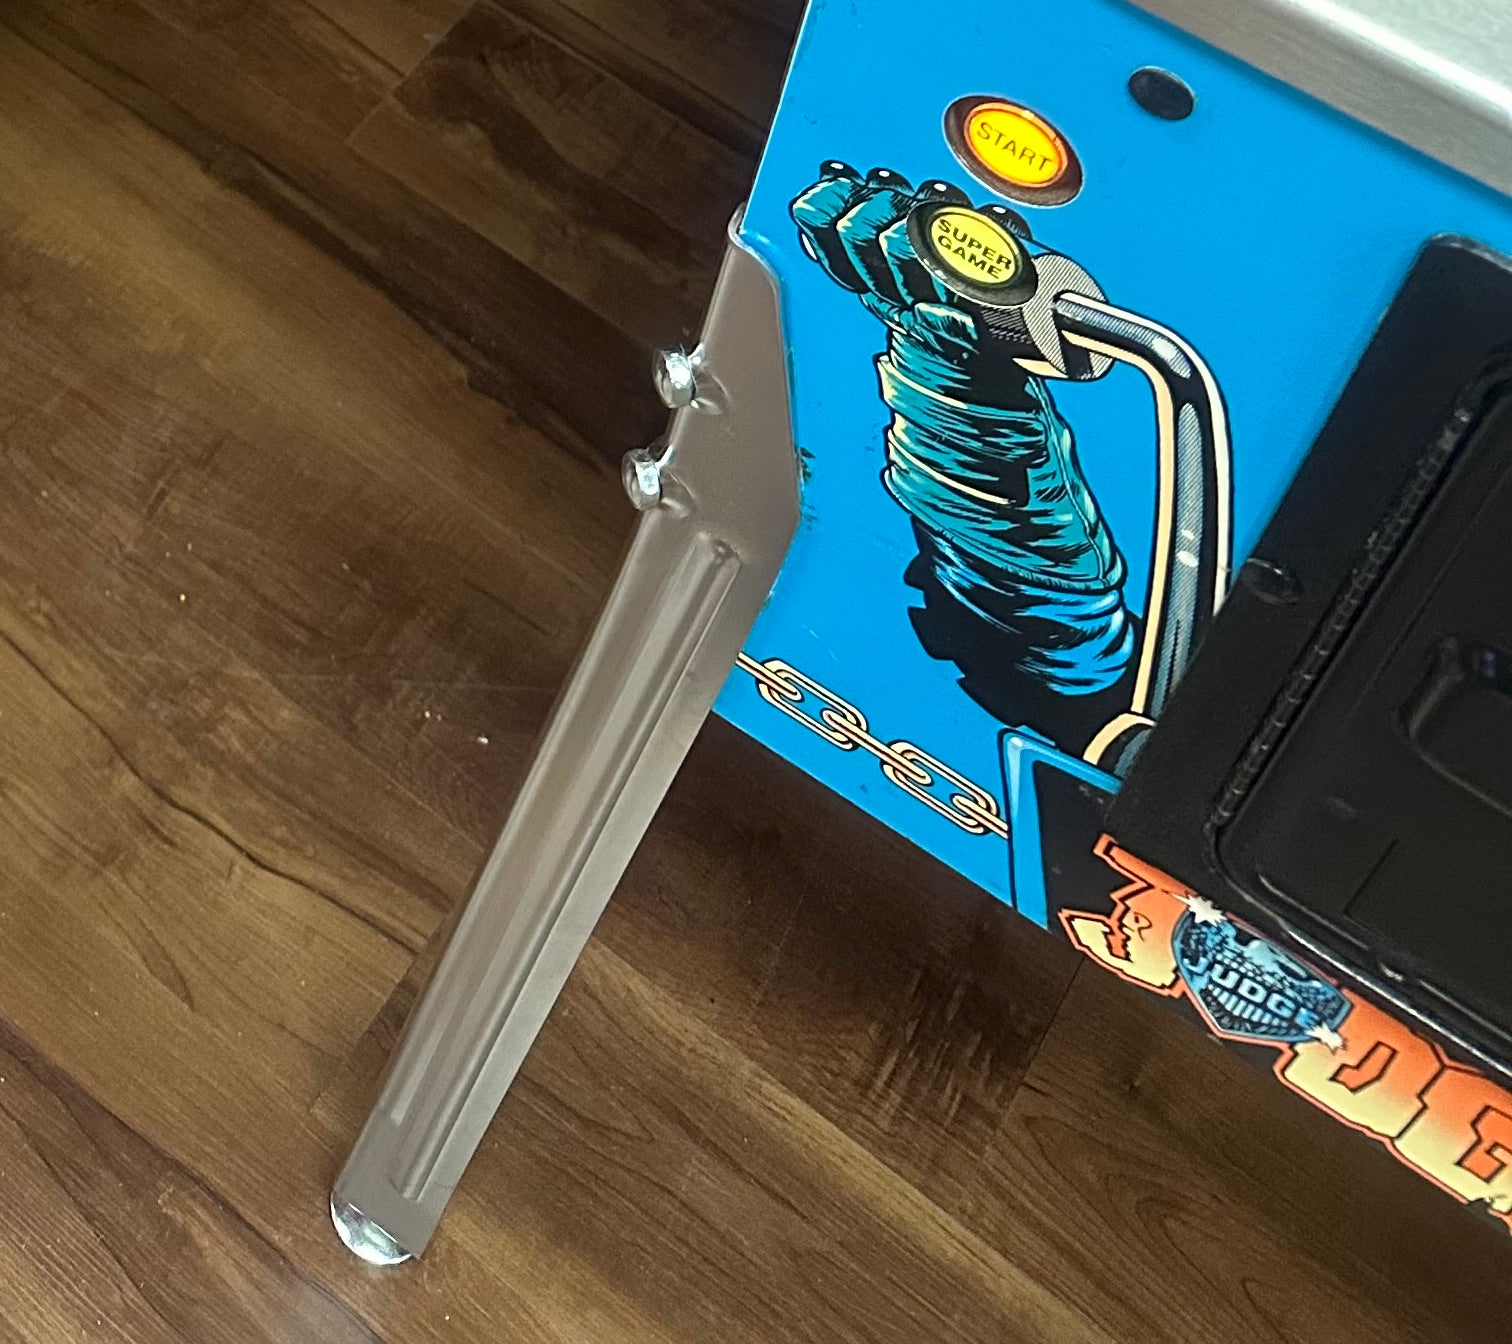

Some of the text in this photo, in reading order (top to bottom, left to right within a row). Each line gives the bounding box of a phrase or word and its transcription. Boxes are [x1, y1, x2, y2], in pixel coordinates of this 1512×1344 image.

[977, 122, 1053, 171] START
[938, 219, 1012, 270] SUPER
[938, 235, 1002, 279] GAME
